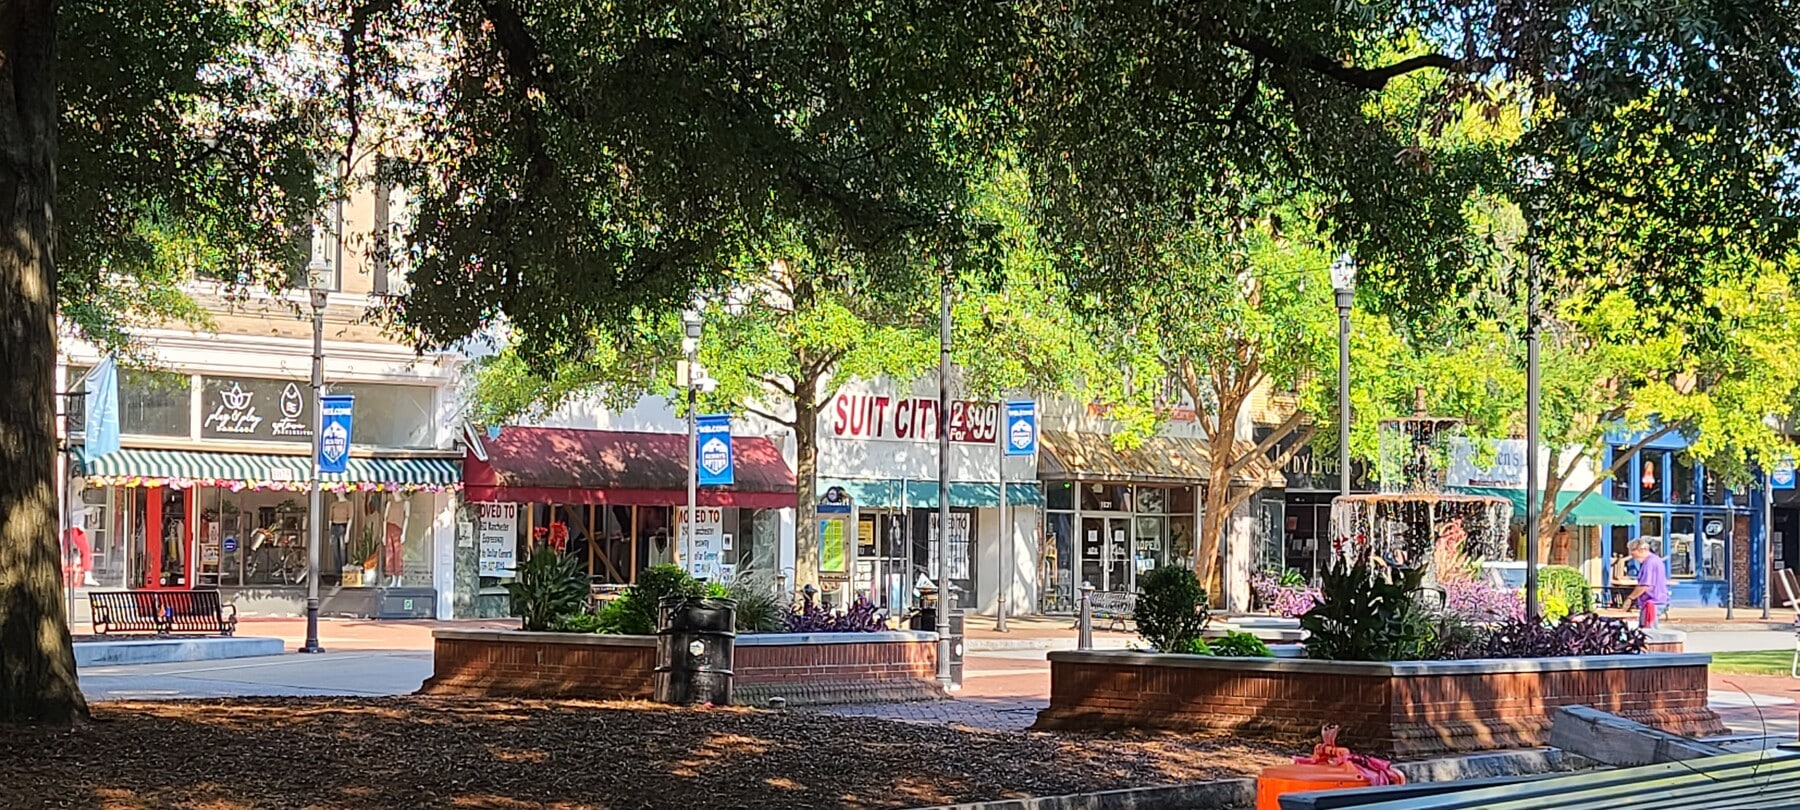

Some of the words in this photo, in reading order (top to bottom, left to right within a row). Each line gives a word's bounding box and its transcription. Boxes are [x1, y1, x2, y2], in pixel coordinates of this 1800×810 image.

[834, 393, 889, 437] SUIT
[951, 402, 964, 427] 2
[966, 404, 997, 439] $99
[699, 425, 730, 433] WELCOME
[949, 428, 965, 441] For
[480, 504, 502, 518] OVED
[504, 505, 515, 519] TO
[679, 509, 706, 523] MOED
[708, 509, 720, 523] TO
